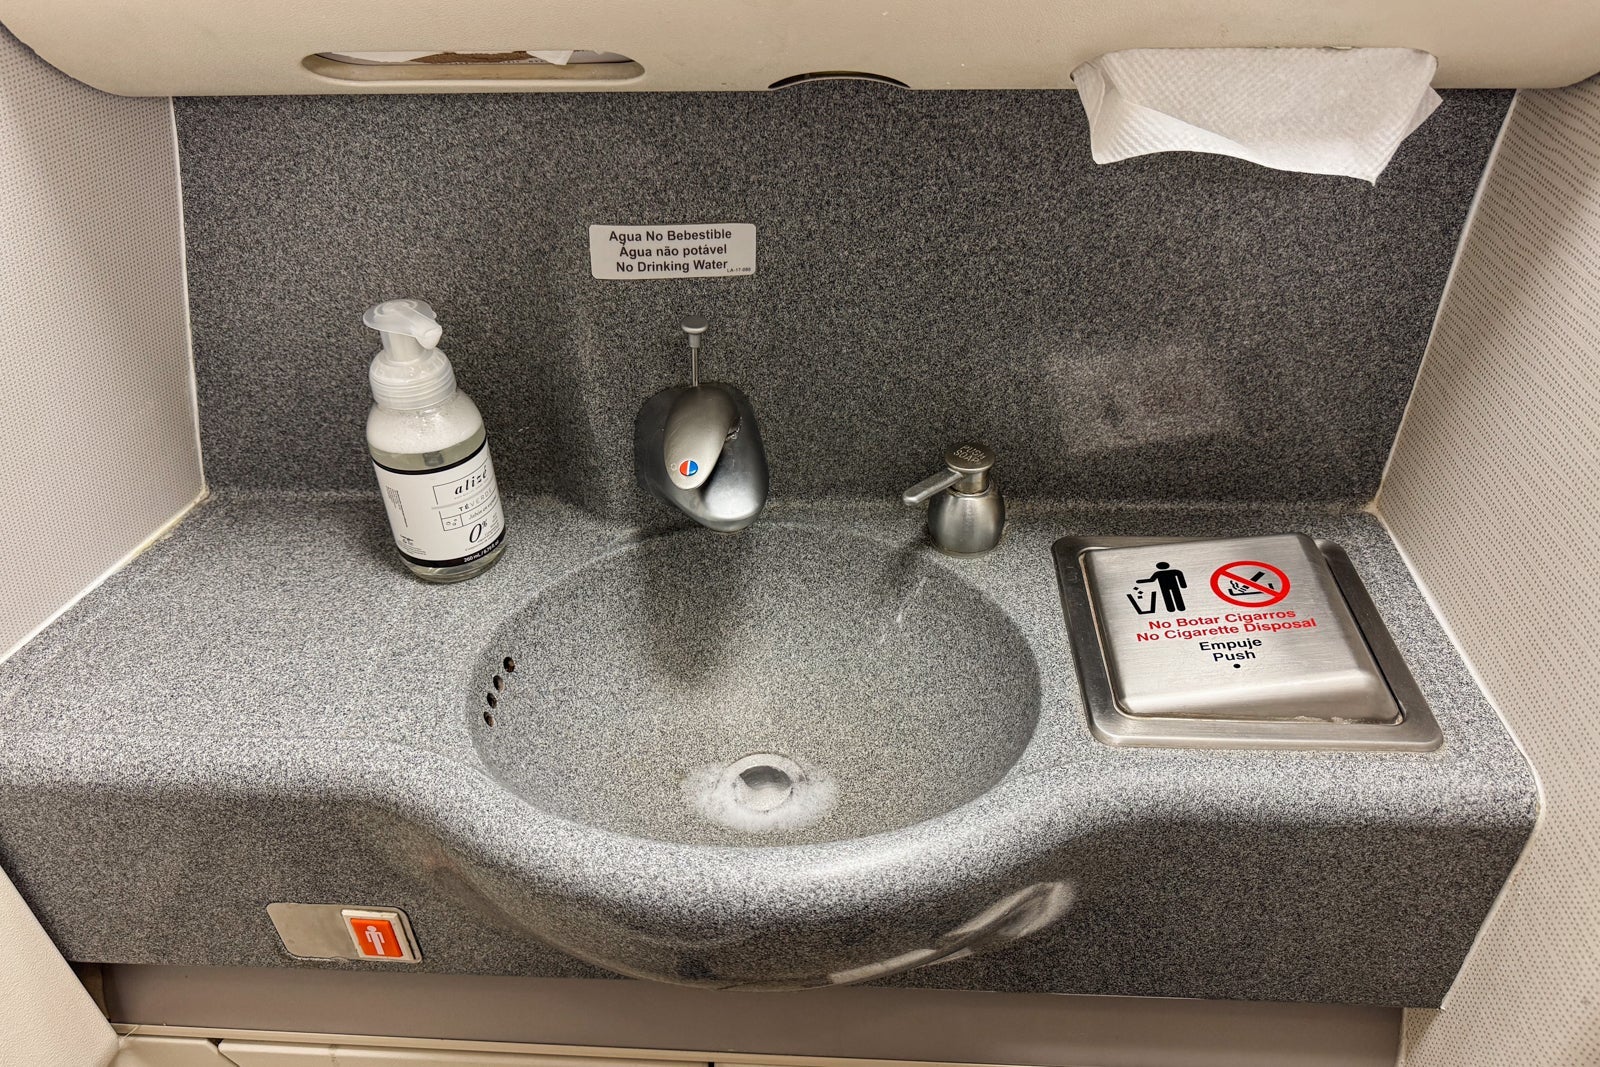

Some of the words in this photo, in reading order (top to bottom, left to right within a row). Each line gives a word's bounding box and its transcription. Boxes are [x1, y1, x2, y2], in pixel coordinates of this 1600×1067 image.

[609, 230, 642, 244] Agua
[646, 230, 663, 241] No
[667, 229, 732, 241] Bebestible
[619, 244, 652, 259] Água
[656, 245, 679, 257] não
[683, 244, 727, 258] potável
[616, 261, 633, 272] No
[637, 260, 690, 273] Drinking
[693, 259, 728, 270] Water
[1148, 618, 1172, 630] No
[1176, 616, 1220, 627] Botar
[1225, 609, 1296, 624] Cigarros
[1136, 631, 1160, 642] No
[1164, 625, 1239, 640] Cigarette
[1244, 618, 1317, 633] Disposal
[1199, 638, 1263, 651] Empuje
[1213, 650, 1256, 662] Push
